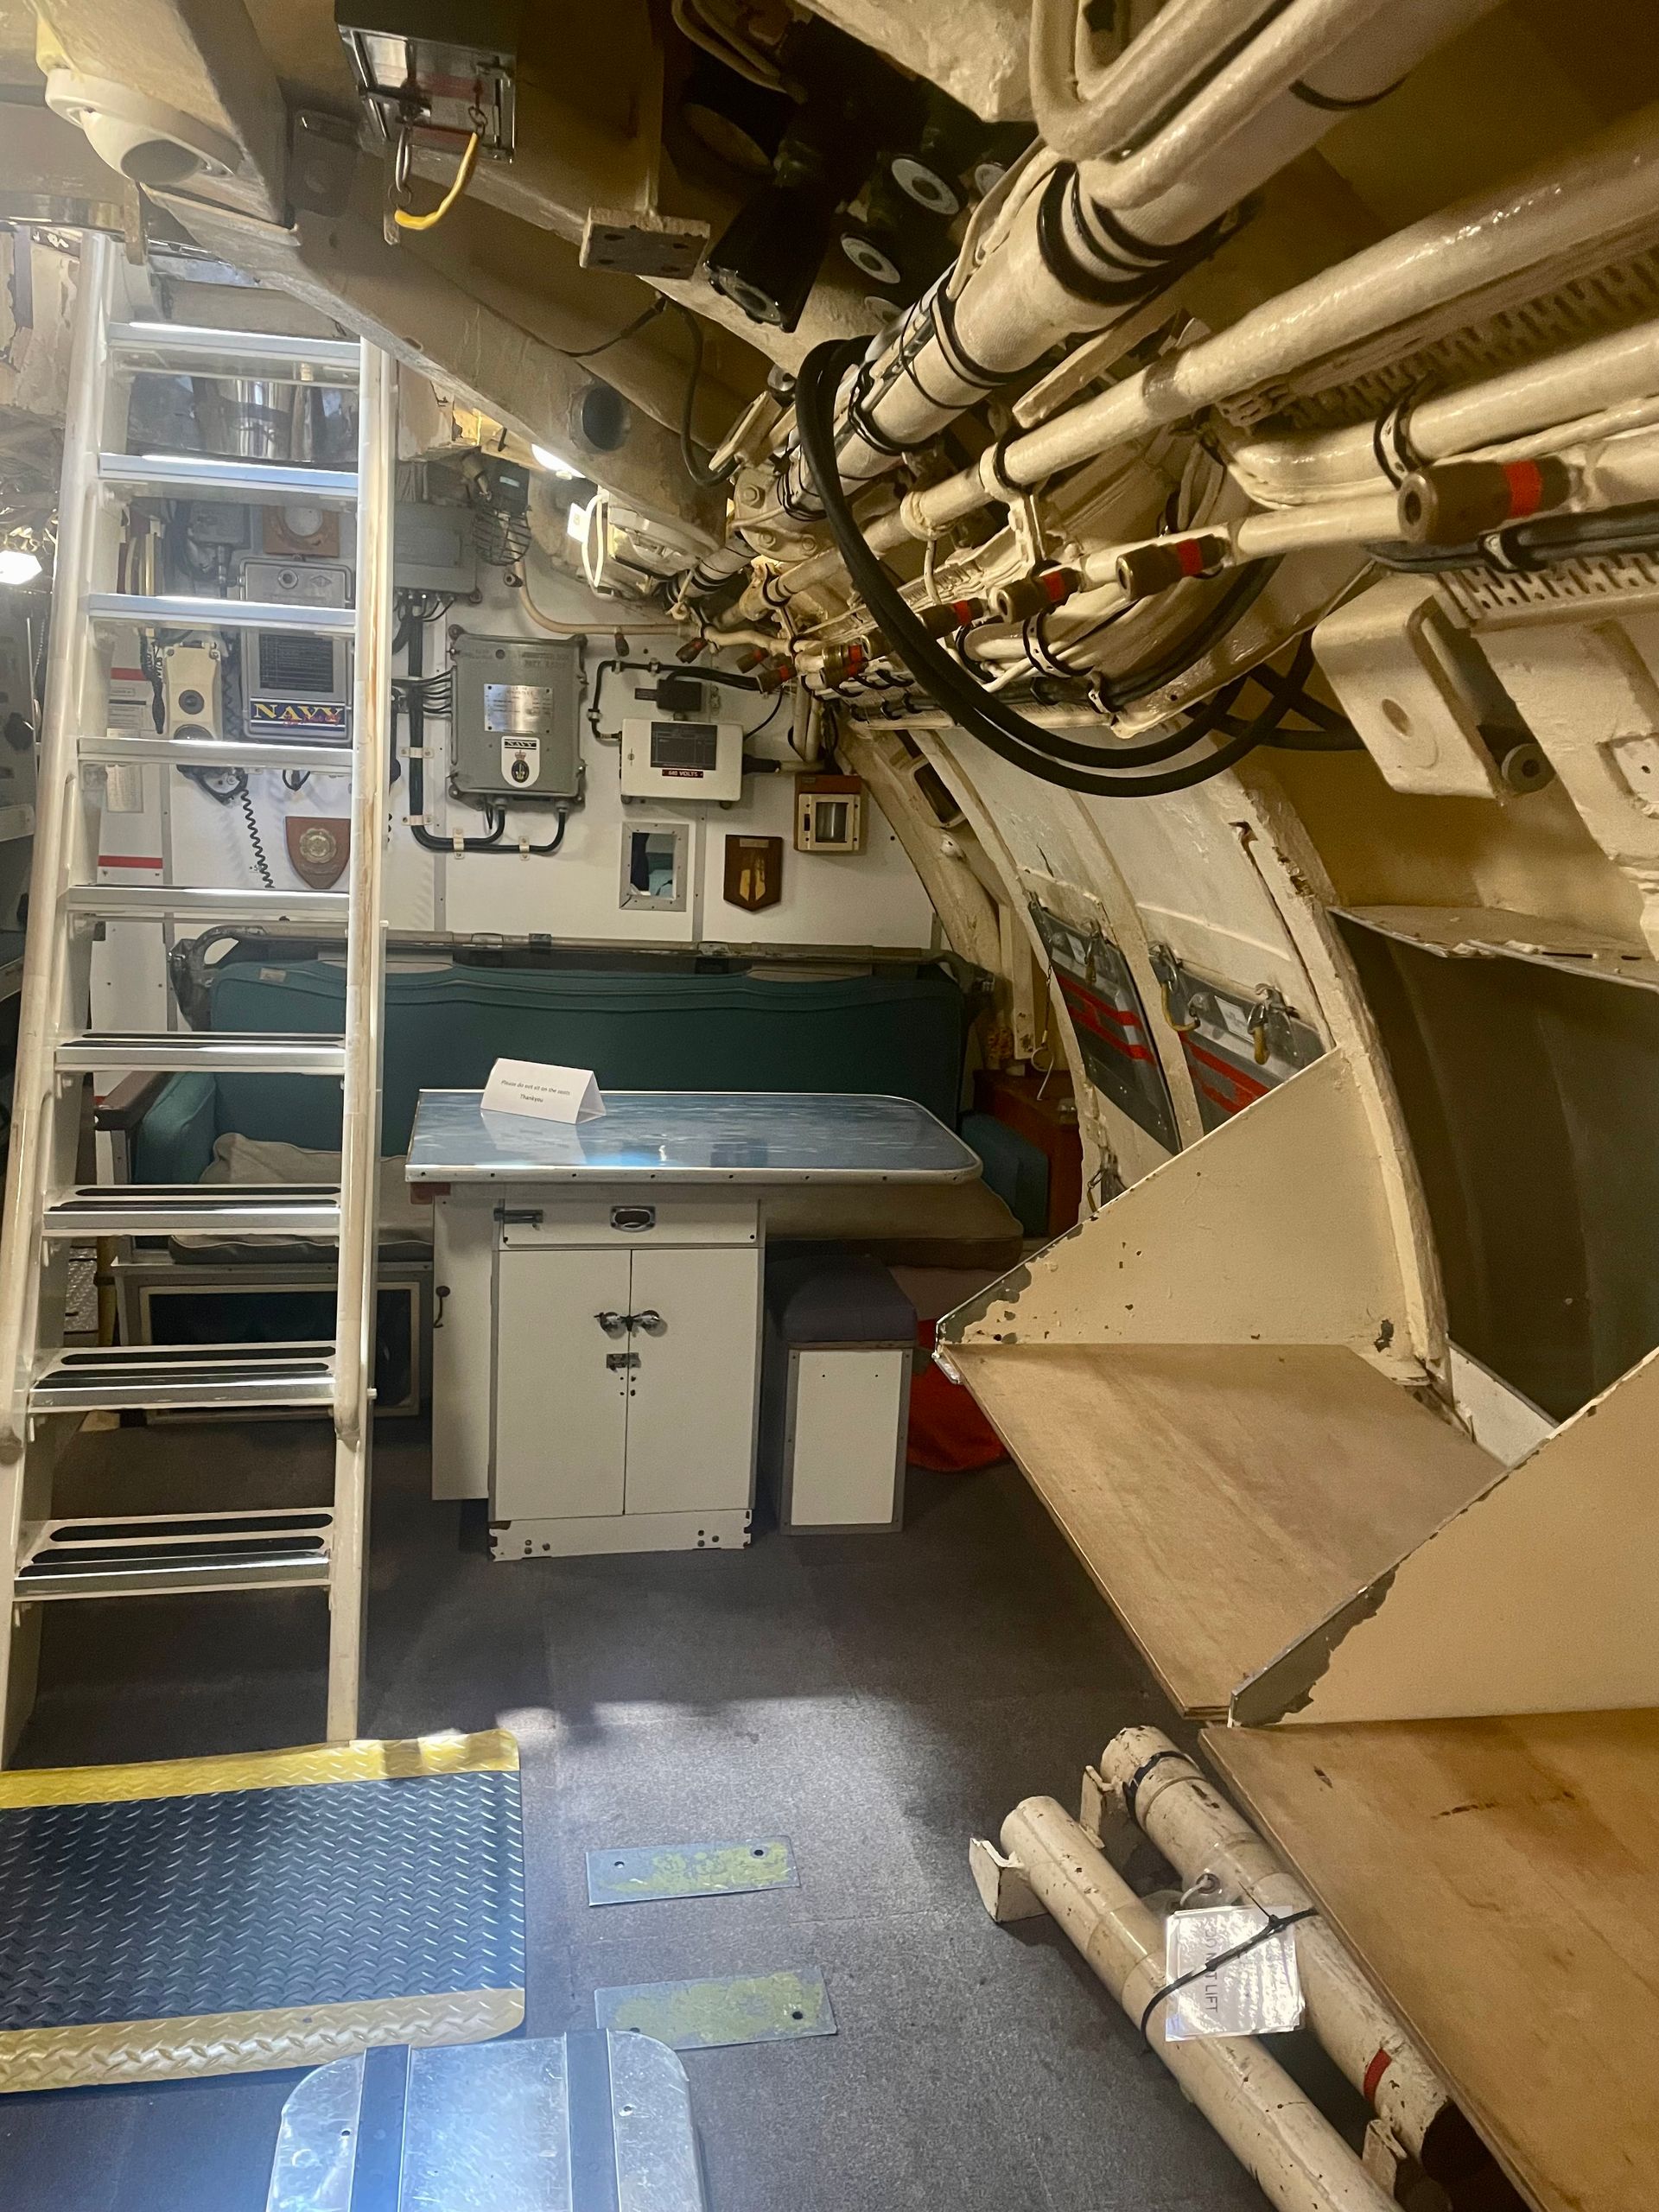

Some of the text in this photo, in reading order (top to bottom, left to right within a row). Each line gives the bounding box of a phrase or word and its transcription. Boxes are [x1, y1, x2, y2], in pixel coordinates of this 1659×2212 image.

[253, 703, 344, 722] NAVY
[519, 1094, 544, 1103] Thankyou
[1205, 1952, 1217, 1980] NT
[1205, 1984, 1218, 2013] LIFT
